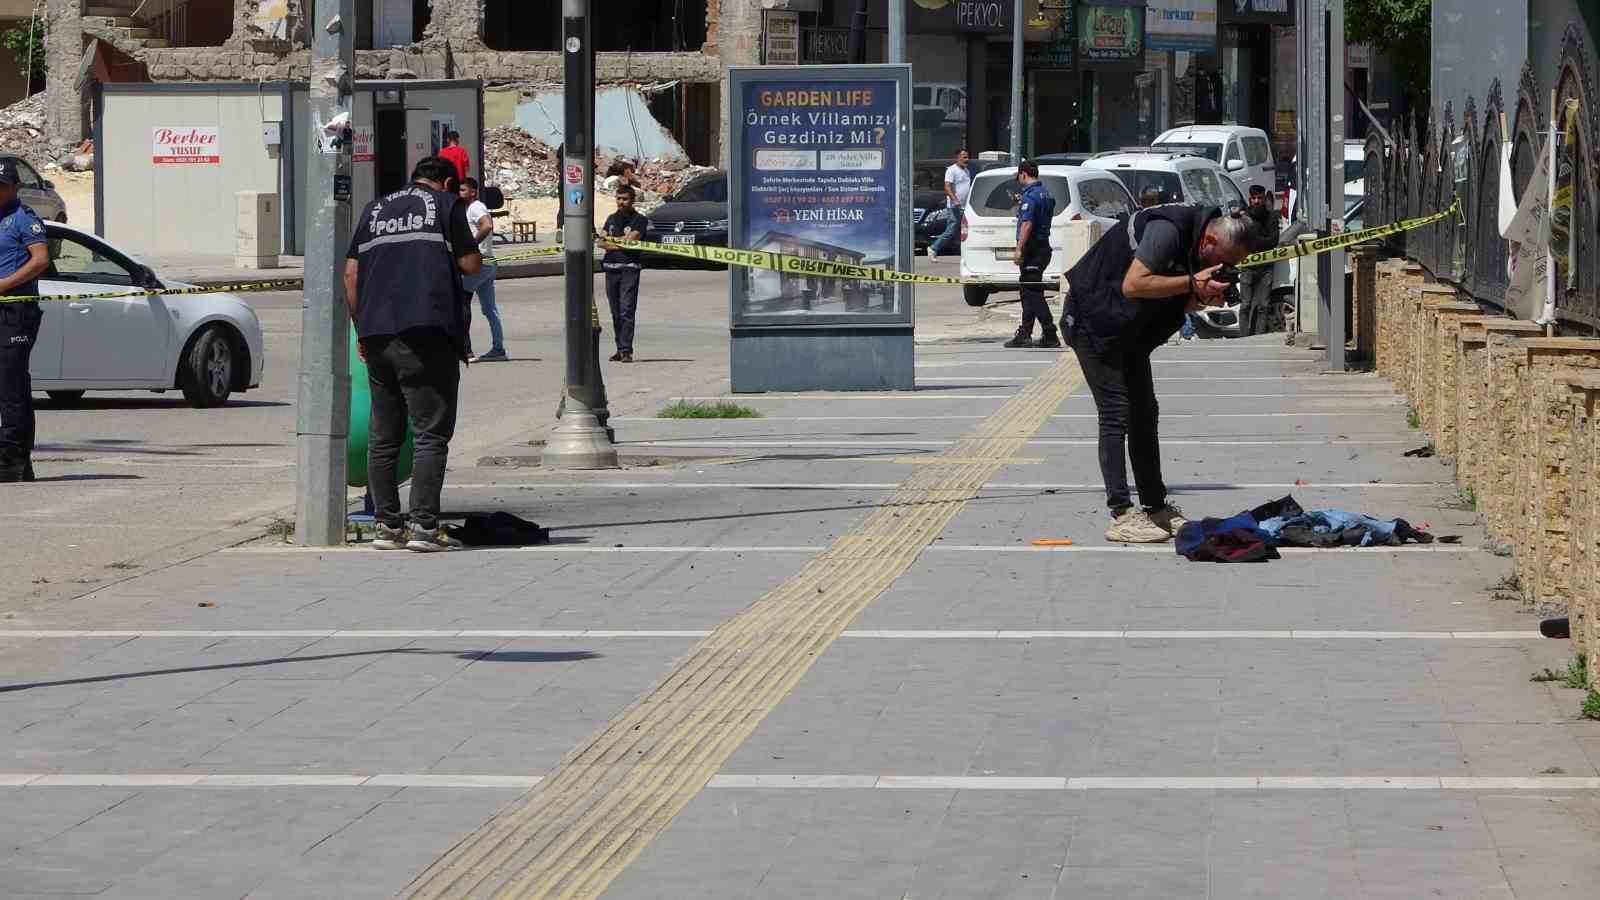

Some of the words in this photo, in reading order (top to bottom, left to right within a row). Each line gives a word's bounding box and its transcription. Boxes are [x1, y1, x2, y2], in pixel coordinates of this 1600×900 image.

[761, 91, 832, 106] GARDEN
[837, 90, 873, 106] LIFE
[747, 109, 801, 125] Örnek
[154, 128, 216, 144] Berber
[765, 131, 844, 144] Gezdiniz
[851, 127, 886, 144] Mi?
[793, 208, 823, 221] YENİ
[827, 208, 864, 221] HİSAR
[376, 213, 424, 235] POLİS
